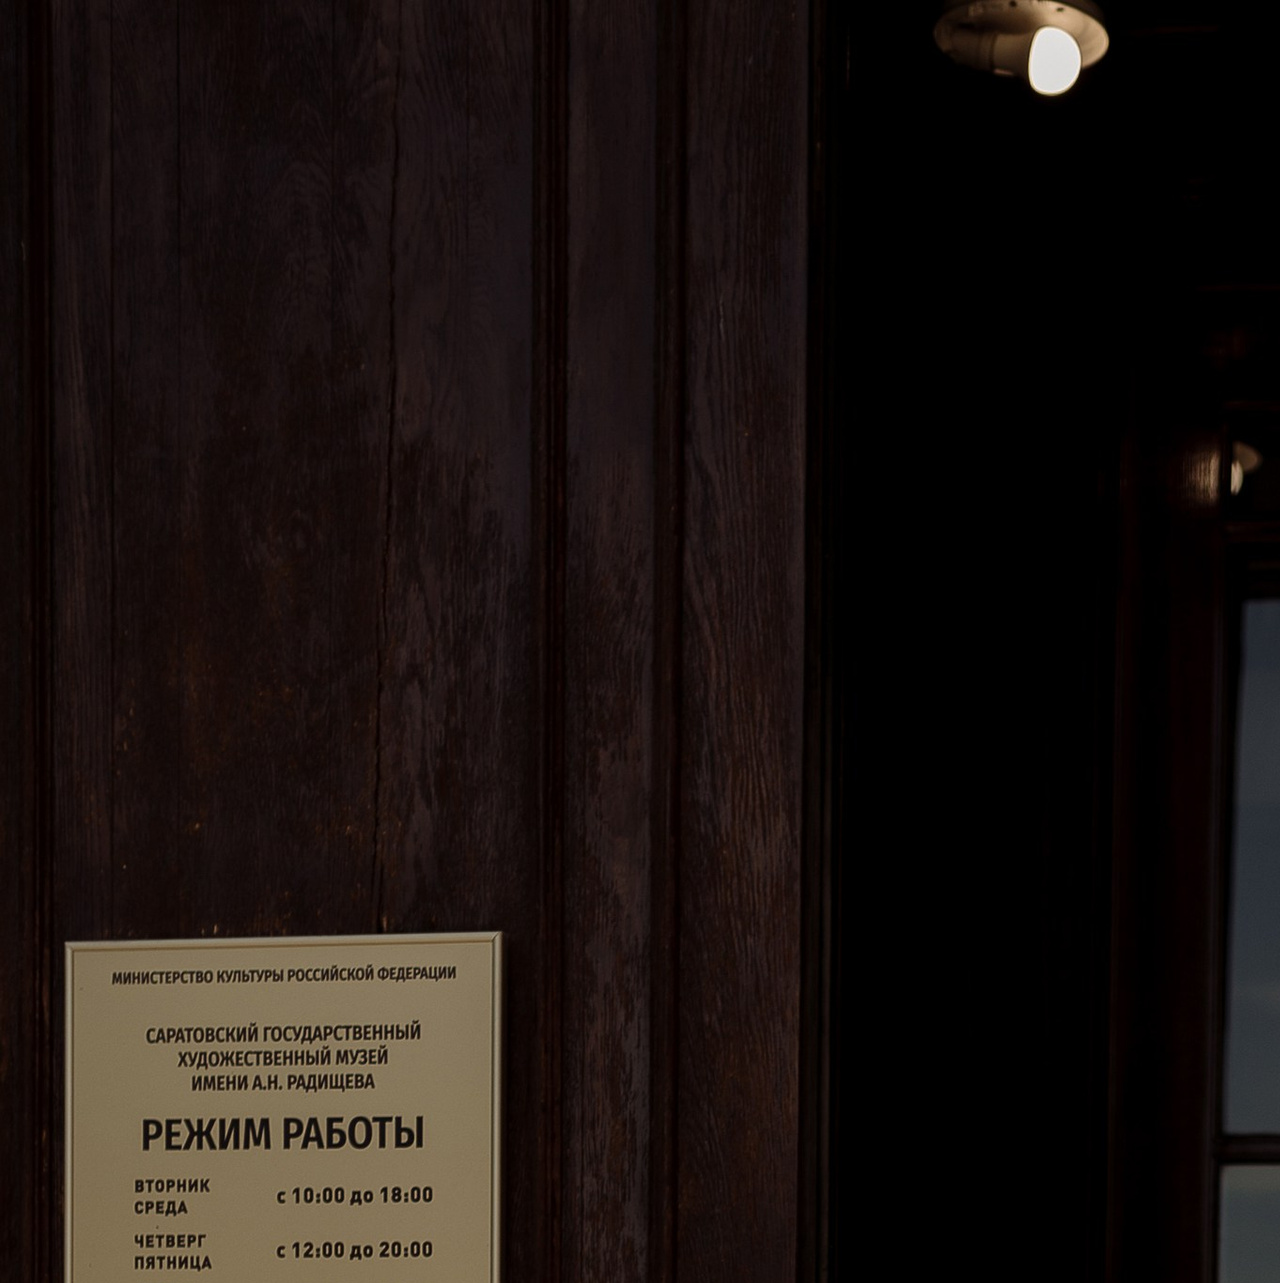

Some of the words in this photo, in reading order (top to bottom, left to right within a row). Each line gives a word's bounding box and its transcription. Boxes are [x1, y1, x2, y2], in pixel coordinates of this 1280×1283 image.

[111, 969, 214, 986] МИНИСТЕРСТВО
[216, 968, 285, 984] КУЛЬТУРЫ
[287, 963, 375, 983] РОССИЙСКОЙ
[376, 965, 457, 983] ФЕДЕРАЦИИ
[145, 1021, 259, 1045] САРАТОВСКИЙ
[262, 1019, 422, 1046] ГОСУДАРСТВЕННЫЙ
[177, 1044, 332, 1071] ХУДОЖЕСТВЕННЫЙ
[335, 1044, 389, 1066] МУЗЕЙ
[191, 1074, 249, 1092] ИМЕНИ
[251, 1073, 283, 1091] А.Н.
[286, 1072, 376, 1094] РАДИЩЕВА
[142, 1117, 272, 1152] РЕЖИМ
[282, 1115, 424, 1150] РАБОТЫ
[134, 1178, 211, 1194] ВТОРНИК
[276, 1190, 287, 1205] с
[291, 1186, 345, 1205] 10:00
[349, 1189, 374, 1207] до
[379, 1185, 433, 1204] 18:00
[134, 1199, 189, 1218] СРЕДА
[134, 1233, 207, 1249] ЧЕТВЕРГ
[276, 1245, 286, 1259] с
[291, 1241, 345, 1259] 12:00
[349, 1244, 374, 1261] до
[379, 1240, 433, 1258] 20:00
[134, 1254, 213, 1273] ПЯТНИЦА
